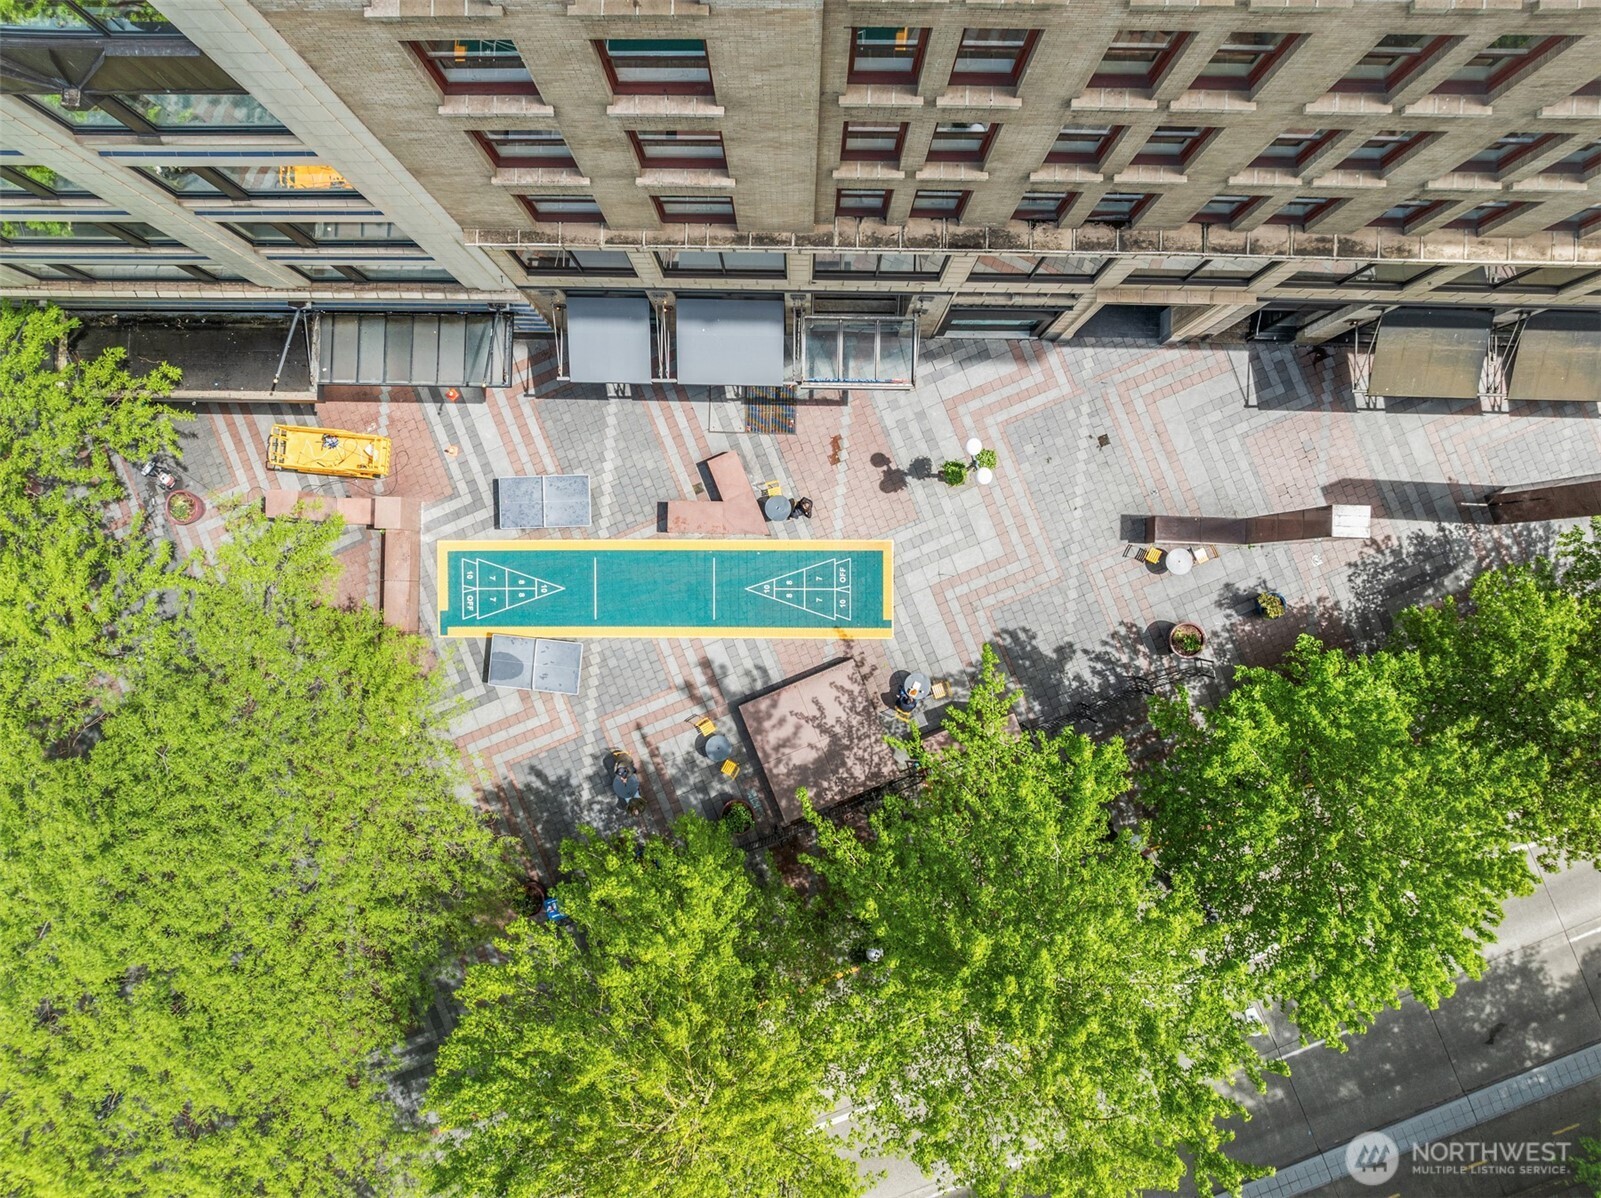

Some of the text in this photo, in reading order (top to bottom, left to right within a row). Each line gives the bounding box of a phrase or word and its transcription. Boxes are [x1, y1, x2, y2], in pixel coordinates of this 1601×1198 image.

[466, 571, 473, 579] 10
[541, 584, 548, 593] 10
[764, 584, 770, 594] 10
[839, 599, 846, 608] 10
